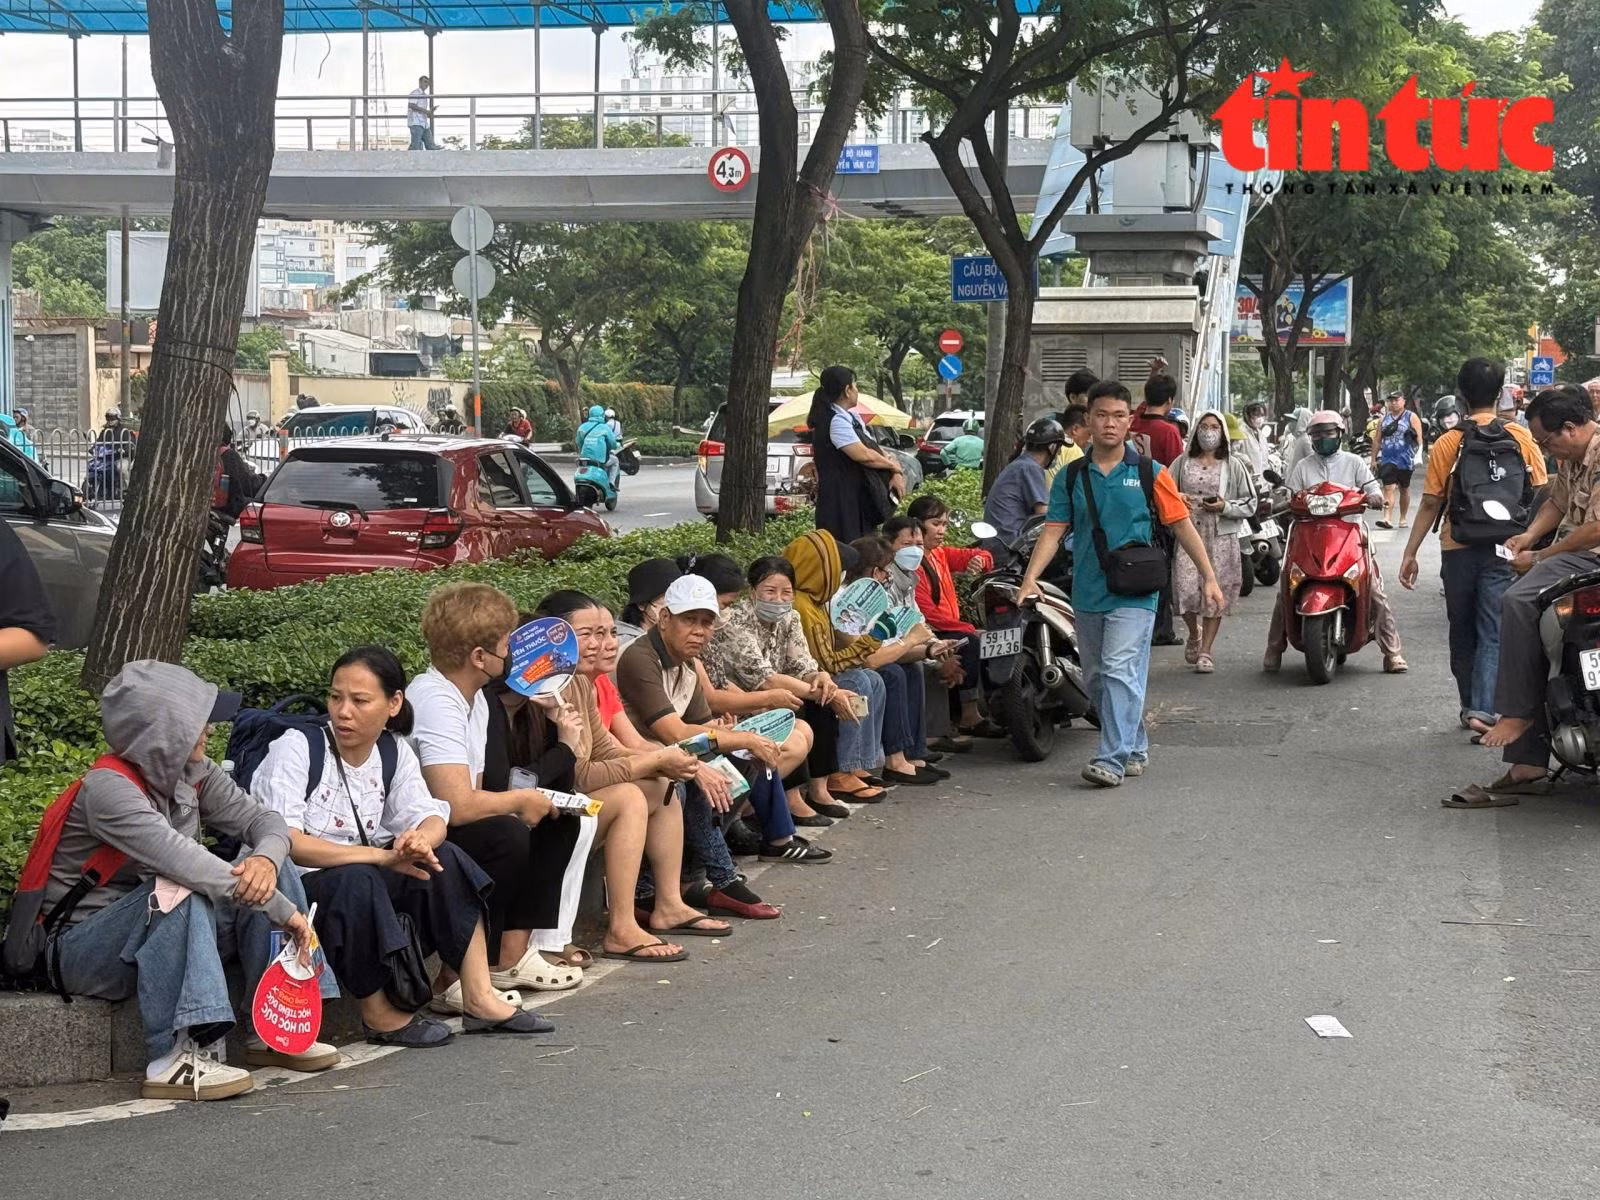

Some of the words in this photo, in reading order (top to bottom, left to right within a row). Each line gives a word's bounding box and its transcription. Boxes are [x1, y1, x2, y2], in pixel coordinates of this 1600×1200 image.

[1122, 478, 1141, 487] UEH
[982, 641, 1019, 657] 172.36
[261, 1001, 279, 1025] ĐỨC
[278, 1017, 297, 1033] HỌC
[298, 1021, 311, 1034] DU
